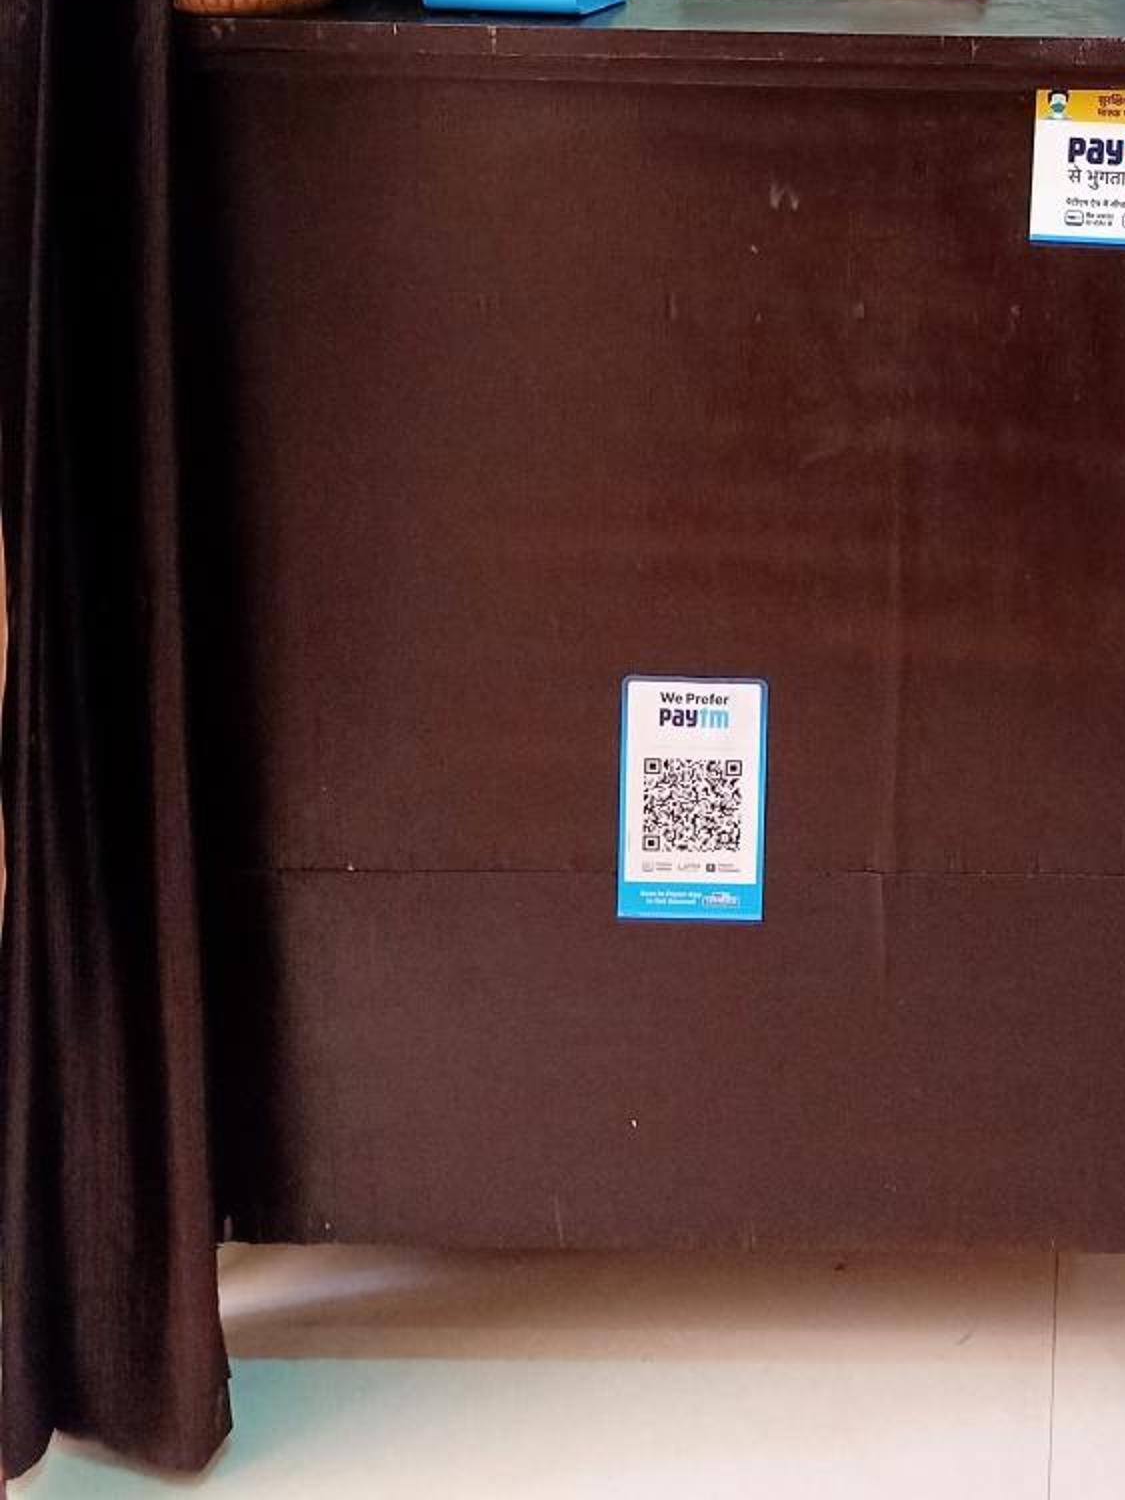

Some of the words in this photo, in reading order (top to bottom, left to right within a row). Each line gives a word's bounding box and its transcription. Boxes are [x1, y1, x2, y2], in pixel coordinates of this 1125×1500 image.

[1068, 164, 1082, 183] से
[659, 691, 683, 705] We
[685, 692, 730, 706] Prefer
